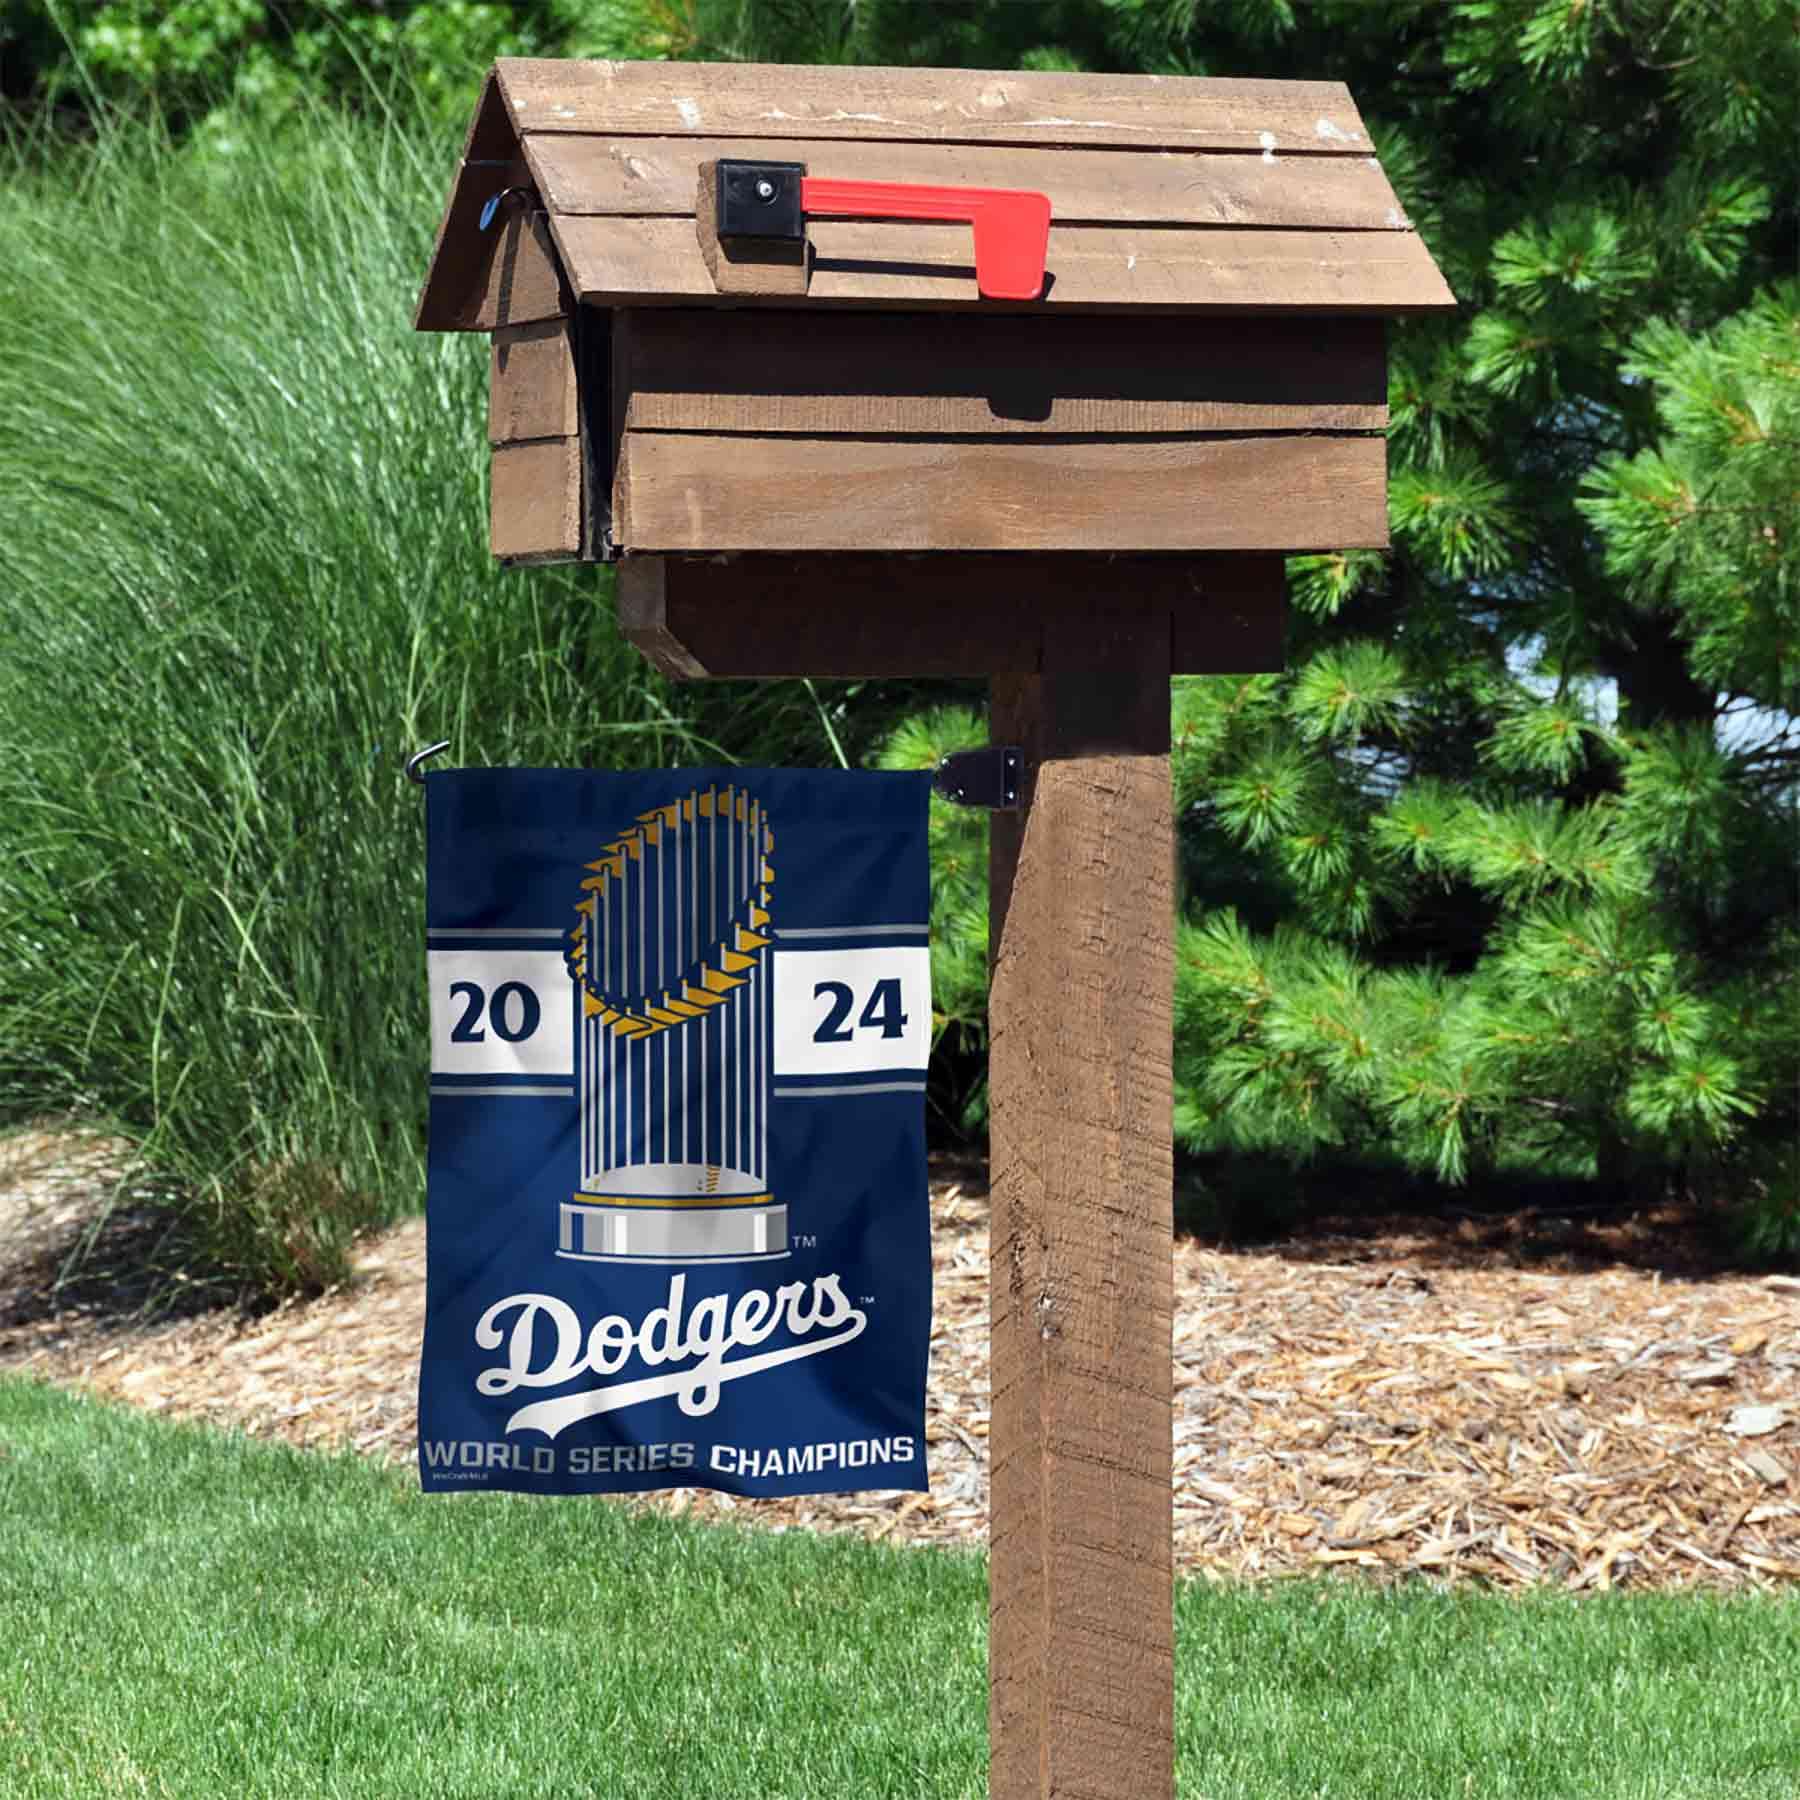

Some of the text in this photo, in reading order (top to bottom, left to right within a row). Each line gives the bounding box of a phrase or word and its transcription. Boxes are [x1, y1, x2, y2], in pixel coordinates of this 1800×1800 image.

[450, 979, 908, 1043] 20 24
[792, 1235, 817, 1249] TM
[475, 1273, 868, 1438] Dodgers
[424, 1436, 914, 1477] WORLD SERIES CHAMPIONS
